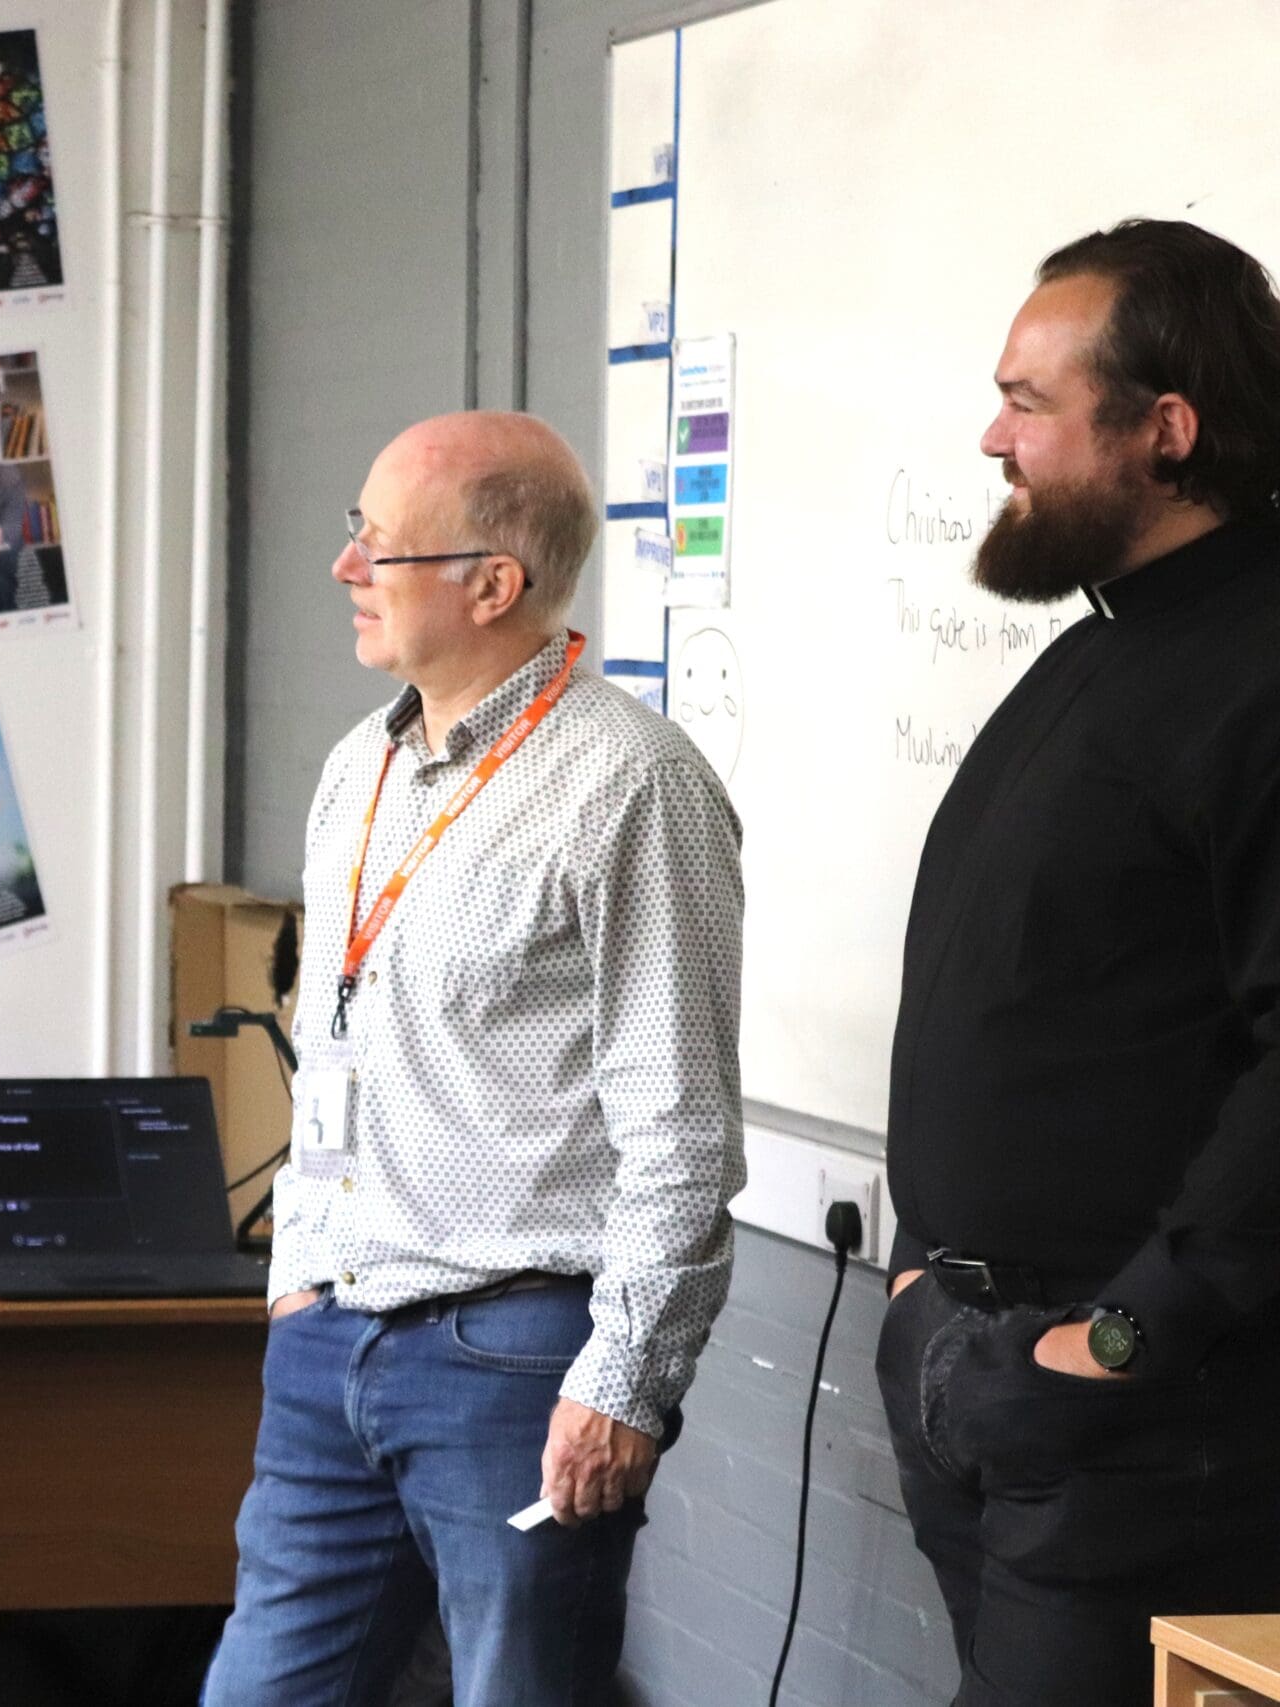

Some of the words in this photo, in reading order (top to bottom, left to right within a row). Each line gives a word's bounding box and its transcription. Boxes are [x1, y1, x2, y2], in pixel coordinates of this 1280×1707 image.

[492, 718, 532, 760] VISITOR
[445, 775, 482, 818] VISITOR
[400, 835, 435, 877] VISITOR
[363, 896, 393, 940] VISITOR
